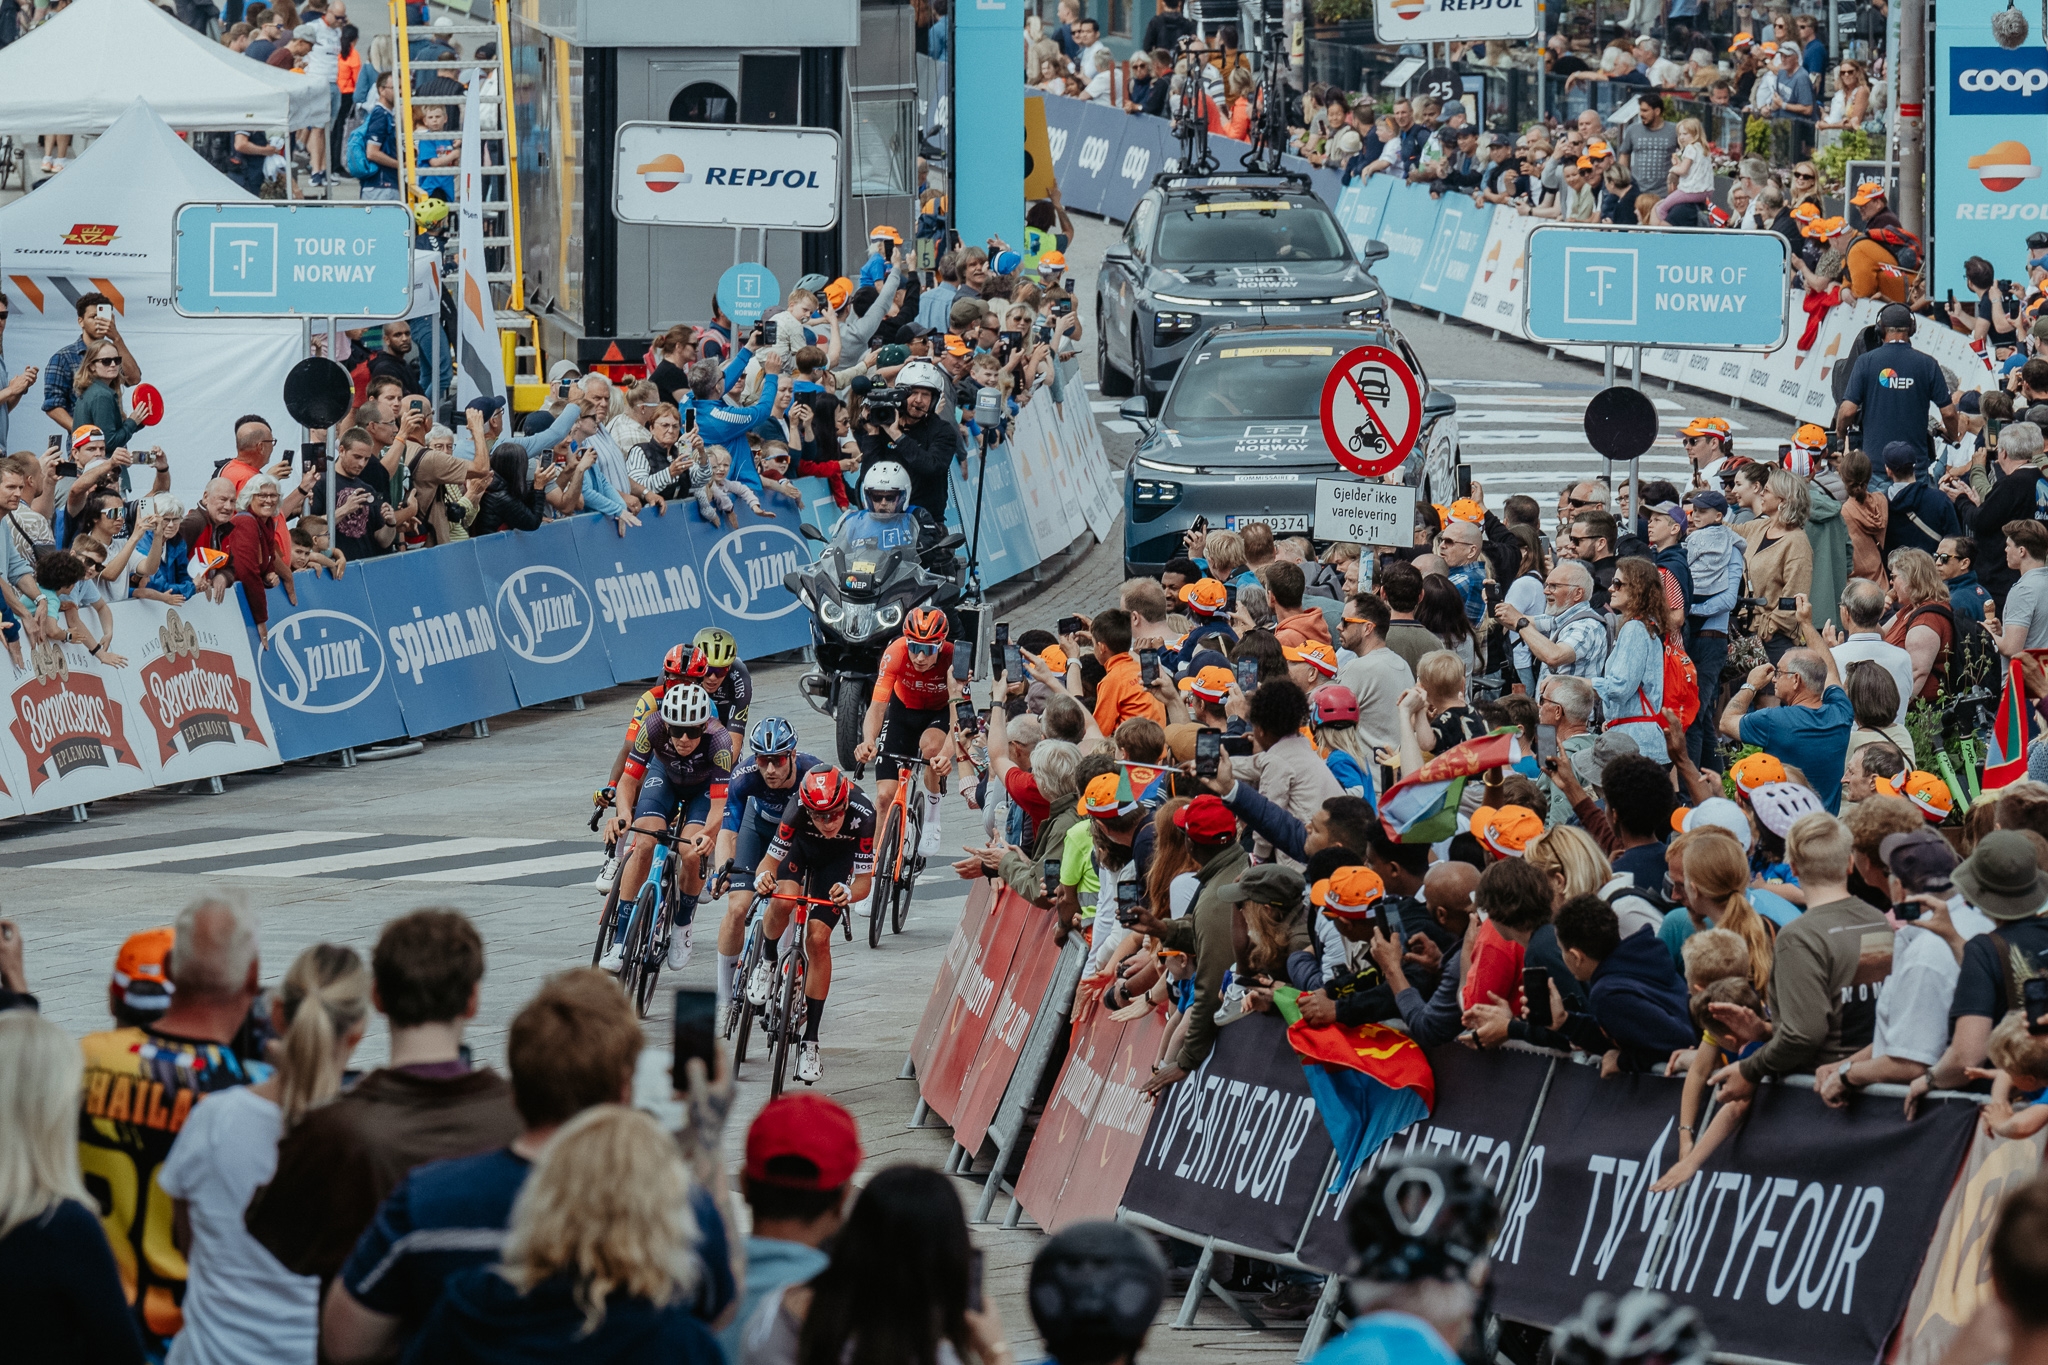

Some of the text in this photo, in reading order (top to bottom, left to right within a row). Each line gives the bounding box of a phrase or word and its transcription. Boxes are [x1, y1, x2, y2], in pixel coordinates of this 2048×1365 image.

[1428, 81, 1454, 100] 25
[1958, 68, 2048, 97] coop
[1078, 135, 1109, 178] coop
[1120, 145, 1150, 189] coop
[704, 167, 820, 189] REPSOL
[1955, 203, 2048, 220] REPSOL
[13, 247, 149, 258] Statens vegvesen
[294, 237, 377, 256] TOUR OF
[293, 264, 377, 283] NORWAY
[1656, 264, 1748, 285] TOUR OF
[1237, 281, 1299, 289] NORWAY
[734, 309, 762, 317] NORWAY
[1655, 293, 1748, 313] NORWAY
[1195, 352, 1212, 365] F
[1688, 353, 1709, 372] REPSOL
[1719, 361, 1740, 380] REPSOL
[1749, 368, 1770, 388] REPSOL
[1779, 378, 1800, 398] REPSOL
[1888, 377, 1915, 390] NEP
[1234, 444, 1309, 453] NORWAY
[1333, 486, 1398, 505] Gjelder ikke
[1262, 517, 1305, 530] 89374
[1331, 506, 1397, 525] varelevering
[1348, 524, 1380, 539] 06-11
[718, 534, 798, 614] Spinn
[851, 581, 867, 589] NEP
[594, 561, 701, 635] spinn.no
[507, 571, 582, 656] Spinn
[198, 630, 219, 647] 1895
[388, 604, 498, 685] spinn.no
[66, 652, 89, 668] 1895
[274, 618, 370, 705] Spinn
[875, 653, 892, 686] INEOS
[149, 658, 239, 729] Berentsens
[734, 677, 745, 699] UBS
[21, 681, 112, 754] Berentsens
[184, 720, 230, 743] EPLEMOST
[55, 744, 102, 769] EPLEMOST
[1965, 743, 1974, 764] ryde
[84, 1068, 195, 1135] HAILA
